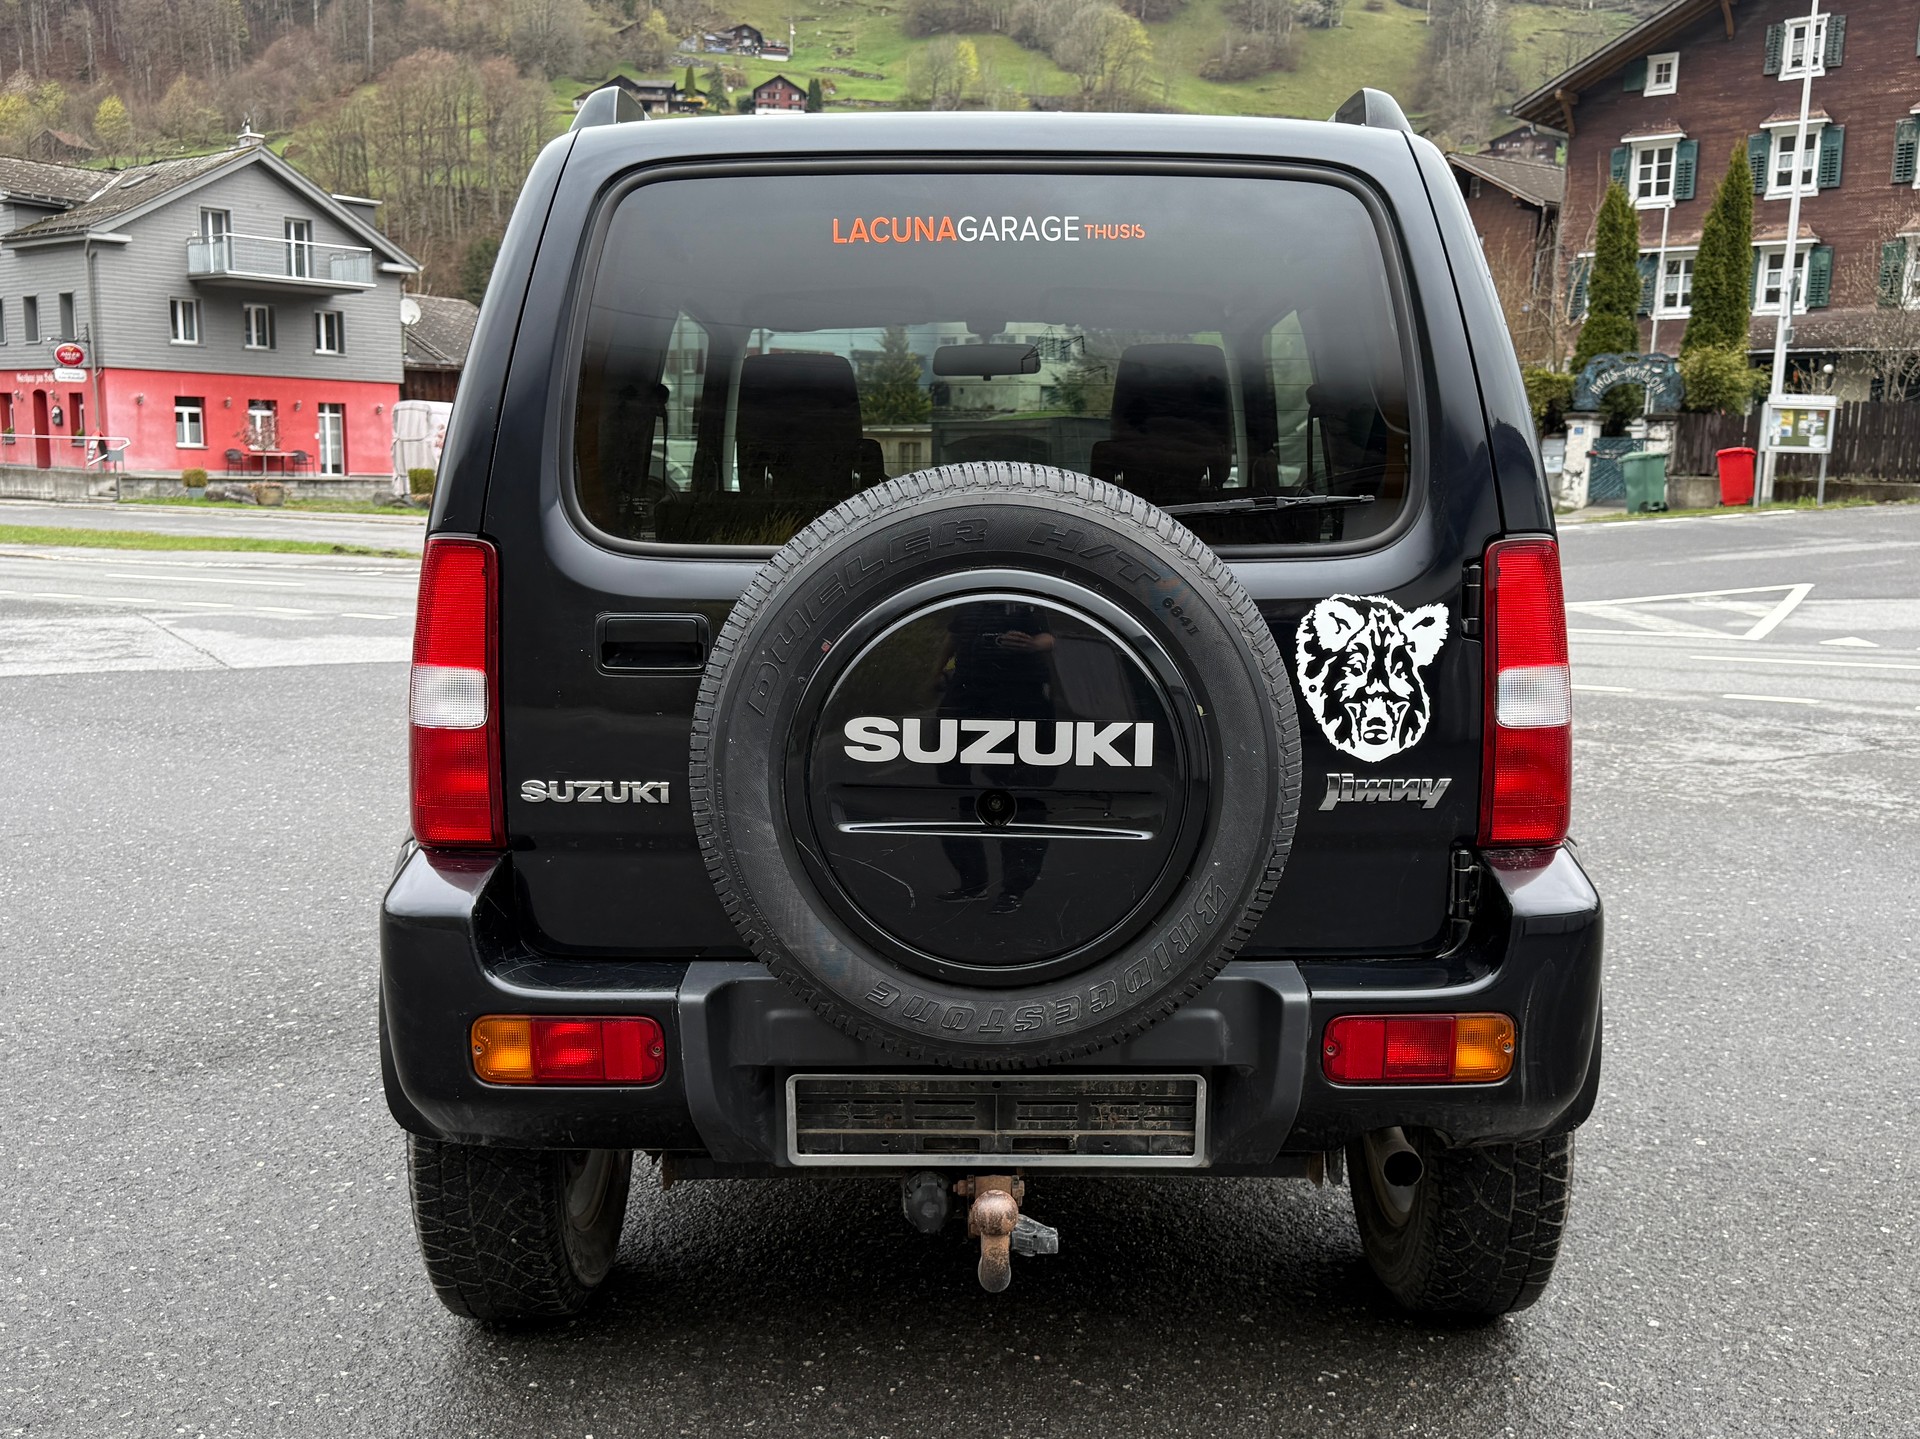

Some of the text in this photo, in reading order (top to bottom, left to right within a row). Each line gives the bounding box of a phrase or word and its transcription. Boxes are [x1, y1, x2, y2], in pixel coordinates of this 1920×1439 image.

[1084, 223, 1146, 240] THUSIS
[746, 517, 994, 717] DUELER
[1026, 521, 1160, 587] H/T
[844, 717, 1154, 767] SUZUKI
[520, 779, 670, 804] SUZUKI
[1318, 772, 1453, 812] Jimny
[864, 873, 1229, 1034] BRIDGESTONE
